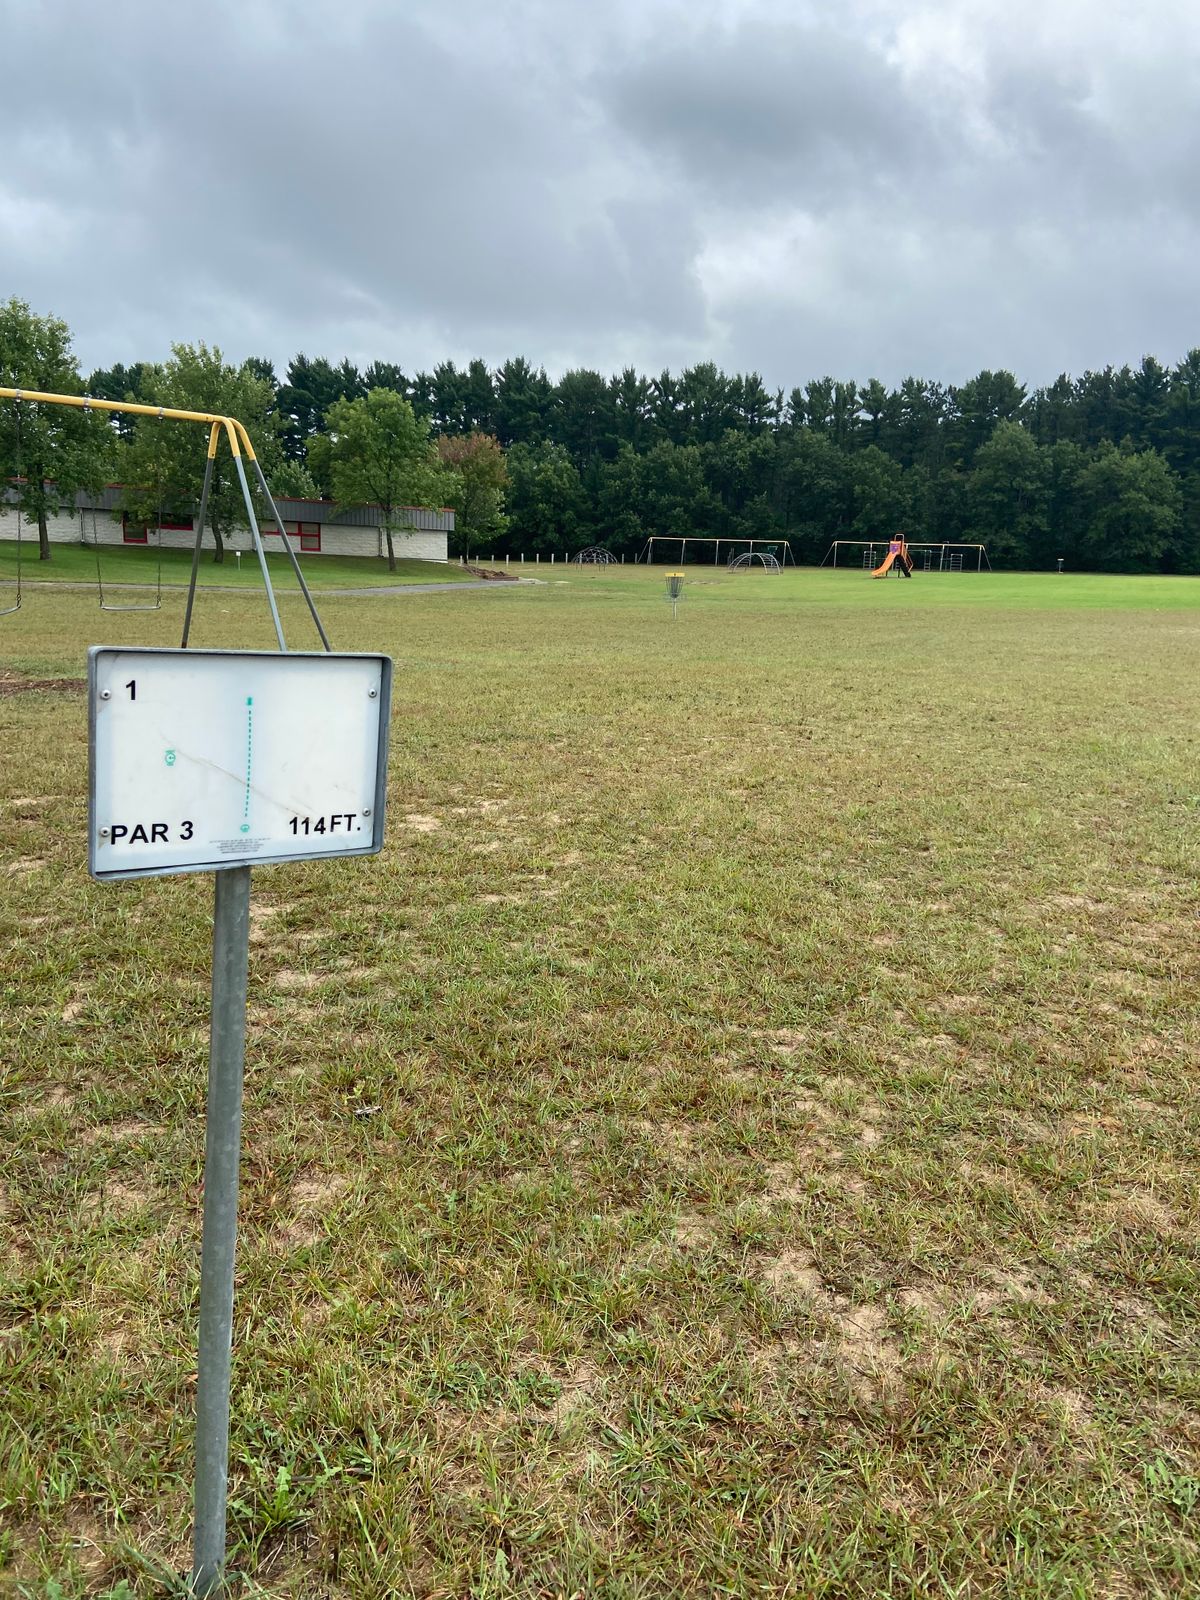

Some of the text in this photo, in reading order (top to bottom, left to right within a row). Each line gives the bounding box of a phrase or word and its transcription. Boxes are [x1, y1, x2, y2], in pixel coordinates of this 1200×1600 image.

[125, 680, 136, 701] 1
[110, 820, 194, 845] PAR 3
